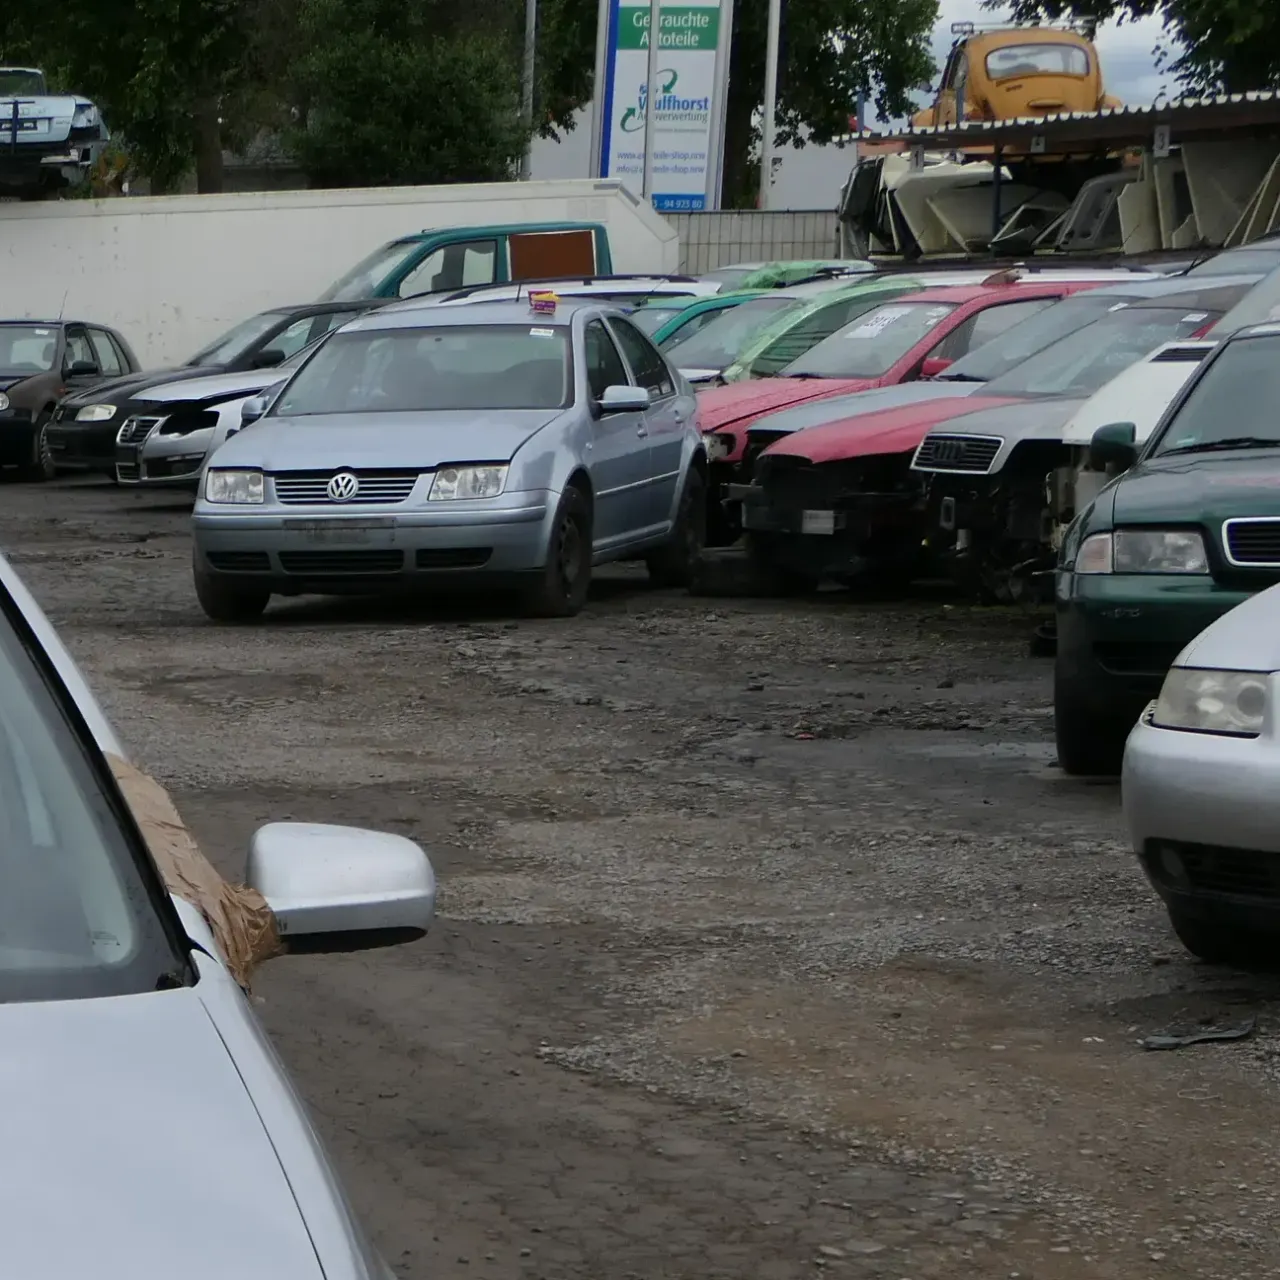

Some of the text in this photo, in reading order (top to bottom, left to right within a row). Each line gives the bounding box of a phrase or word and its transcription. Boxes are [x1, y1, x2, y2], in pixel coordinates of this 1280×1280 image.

[633, 11, 710, 28] Gerauchte
[639, 30, 700, 46] Atoteile
[637, 111, 708, 123] Averwertung
[664, 200, 674, 209] 94
